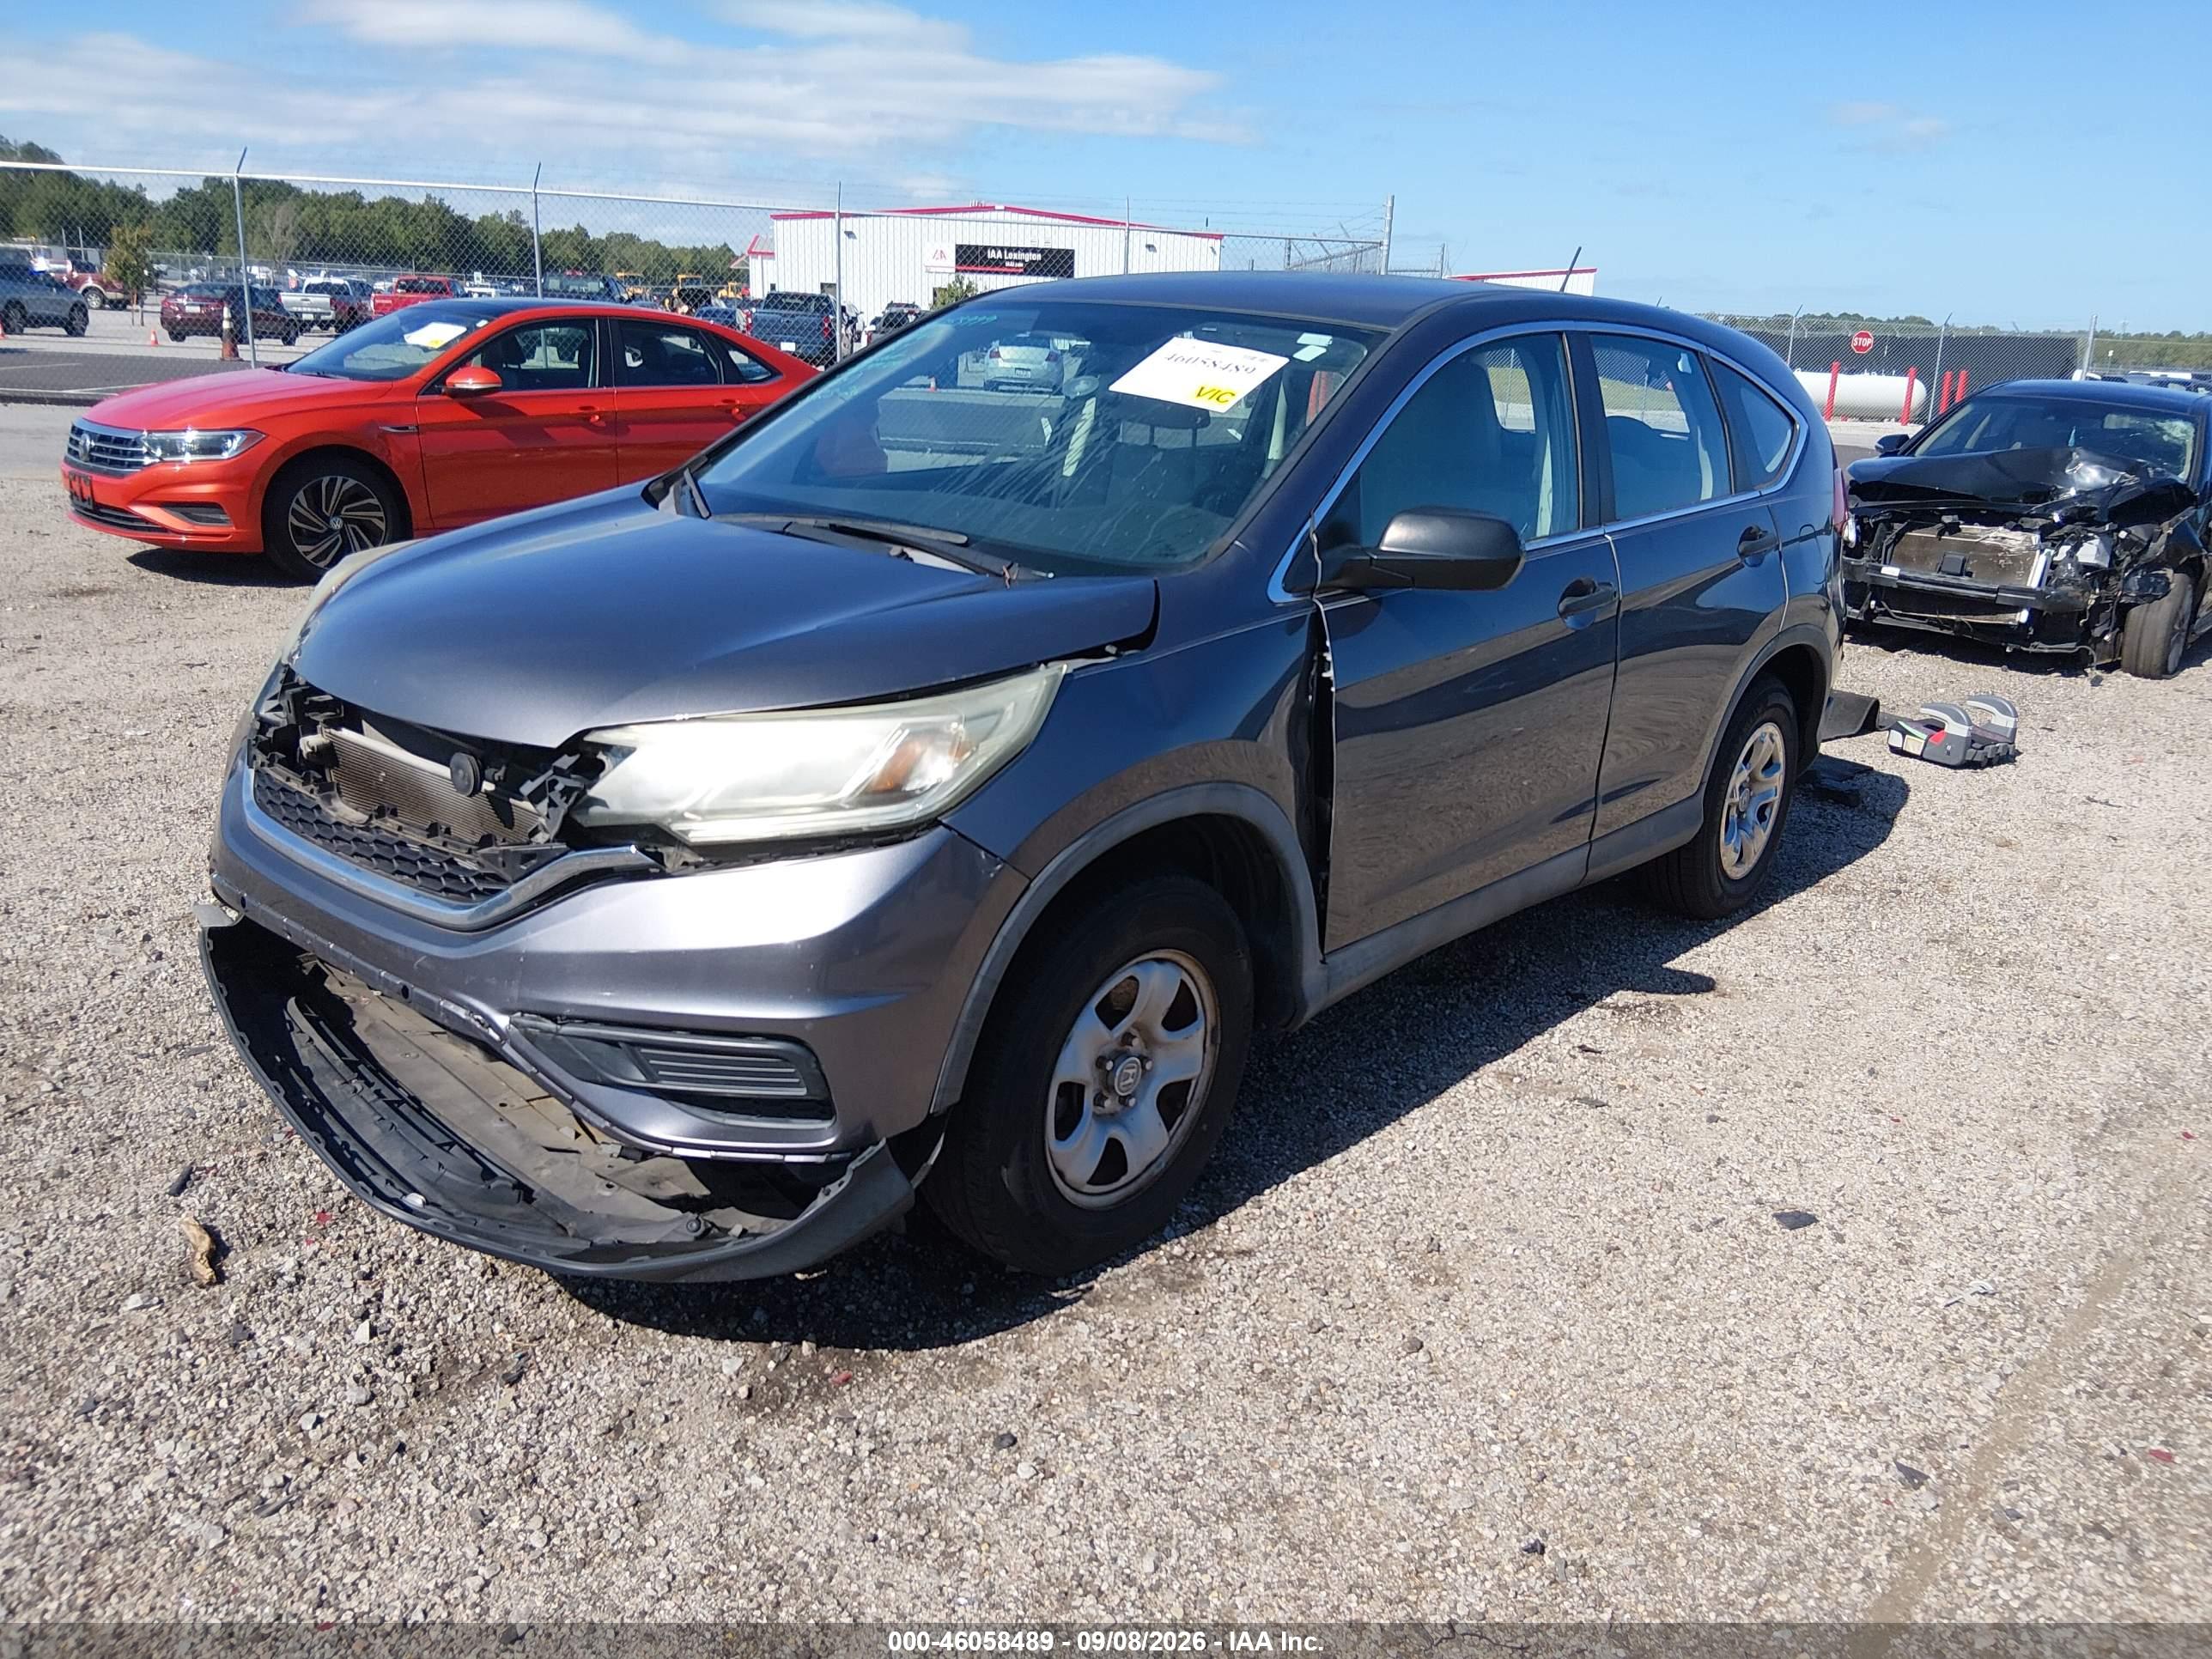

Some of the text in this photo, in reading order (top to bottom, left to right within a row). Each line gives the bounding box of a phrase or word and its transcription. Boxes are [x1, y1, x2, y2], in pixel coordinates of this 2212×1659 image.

[988, 248, 1002, 259] IAA
[1853, 337, 1872, 347] STOP
[1196, 386, 1236, 404] VIC
